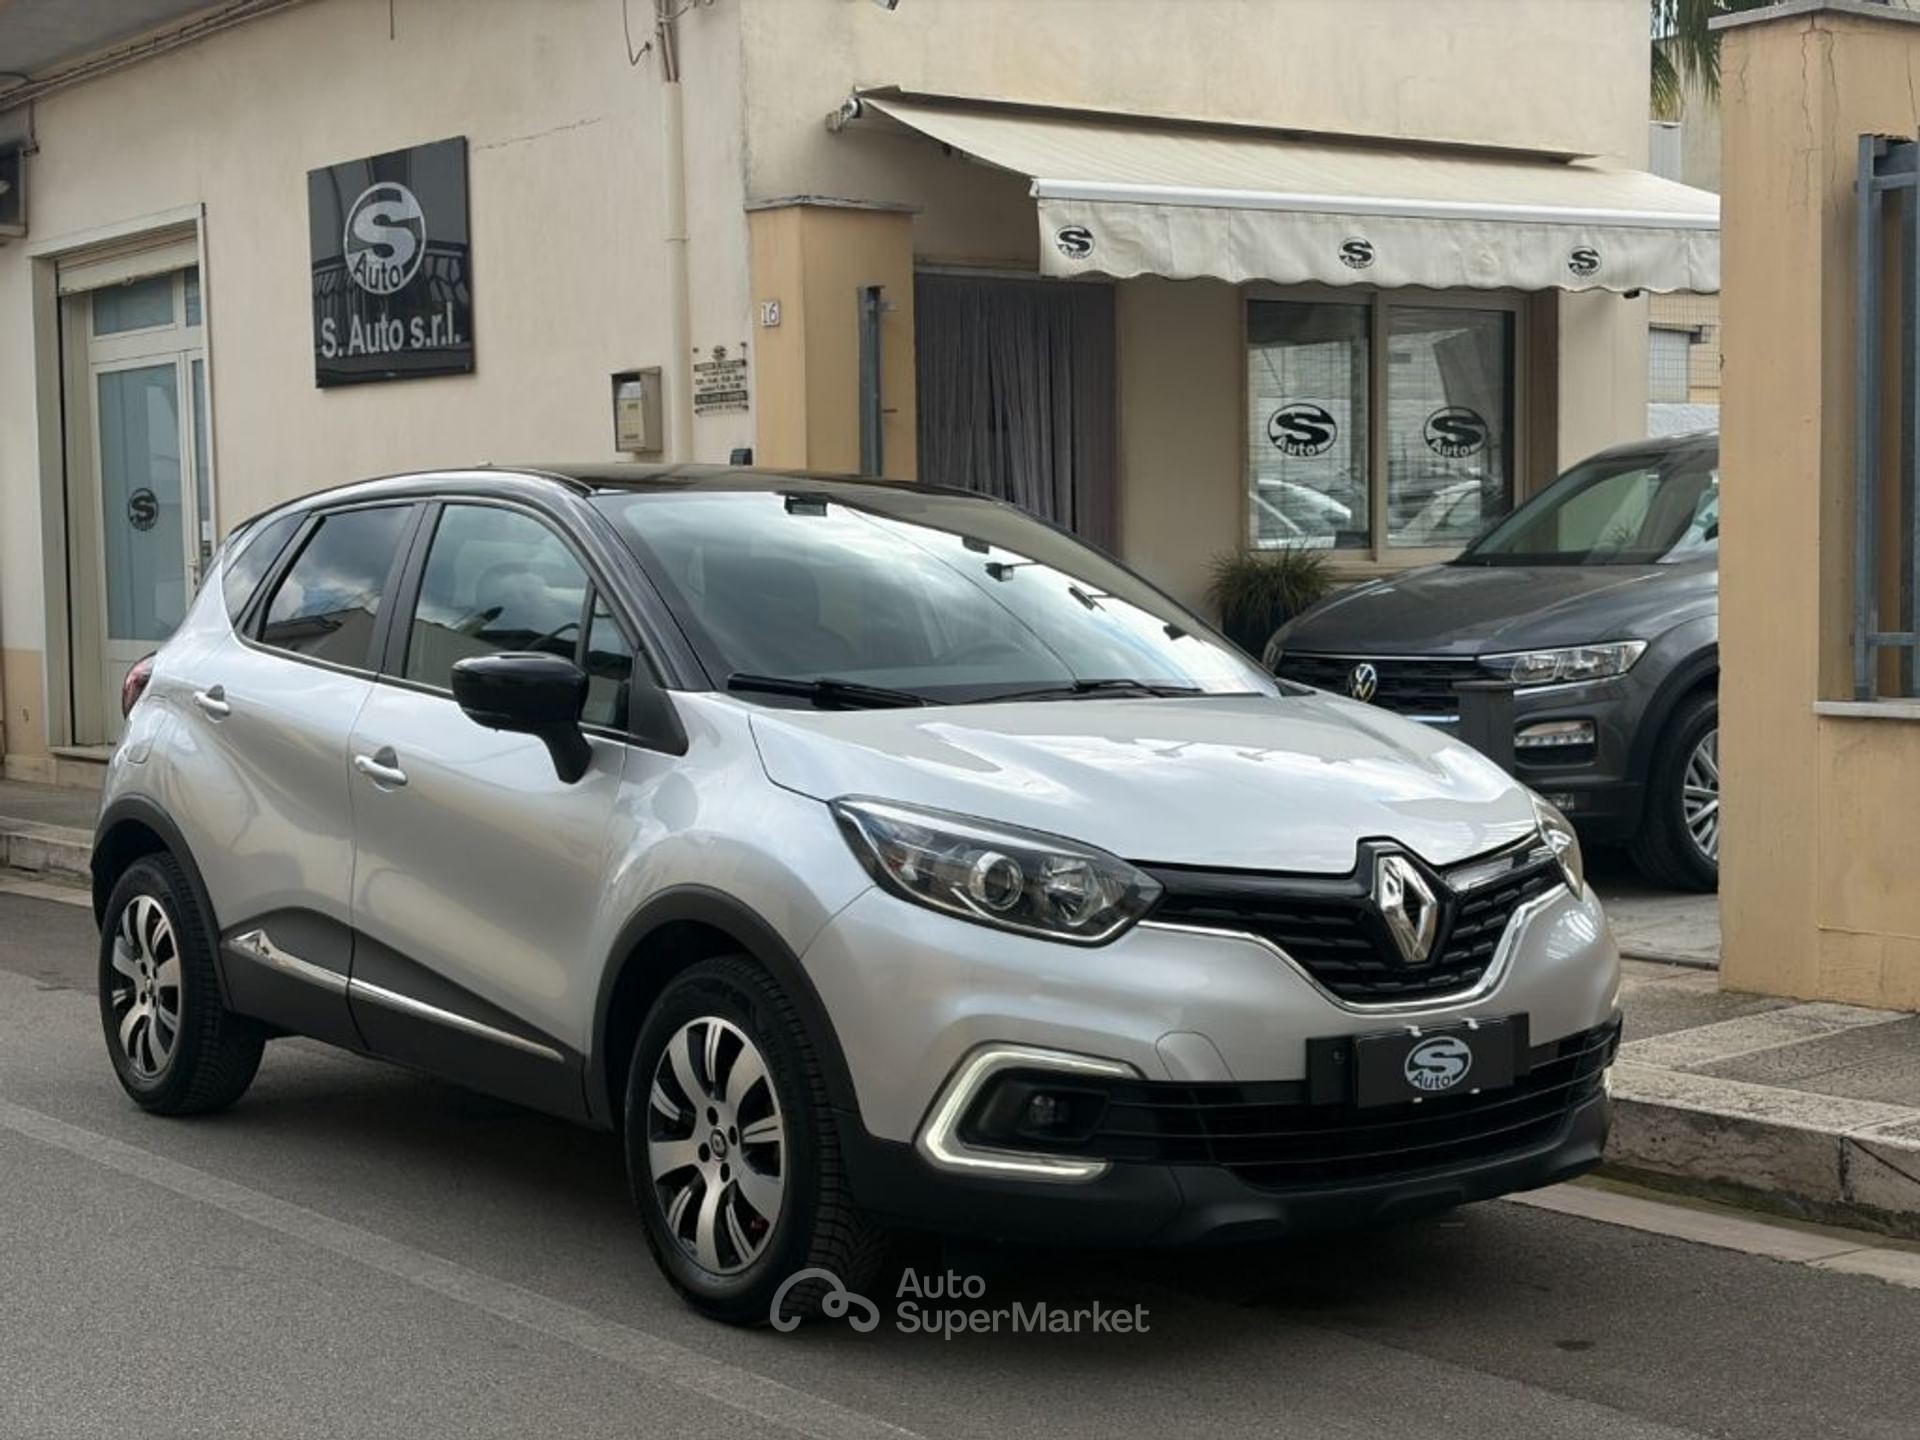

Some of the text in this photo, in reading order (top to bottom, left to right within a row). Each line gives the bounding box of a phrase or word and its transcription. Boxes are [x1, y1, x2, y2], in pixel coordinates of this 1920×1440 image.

[353, 187, 422, 267] S
[1059, 229, 1093, 252] S
[1343, 240, 1373, 262] S
[1571, 249, 1599, 270] S
[353, 251, 402, 292] Auto
[763, 302, 778, 324] 16
[321, 301, 461, 358] S. Auto s.r.l.
[1275, 408, 1335, 446] S
[1431, 413, 1486, 447] S
[1275, 437, 1318, 456] Auto
[1430, 440, 1470, 458] Auto
[1413, 1037, 1471, 1078] S
[1411, 1070, 1452, 1089] Auto
